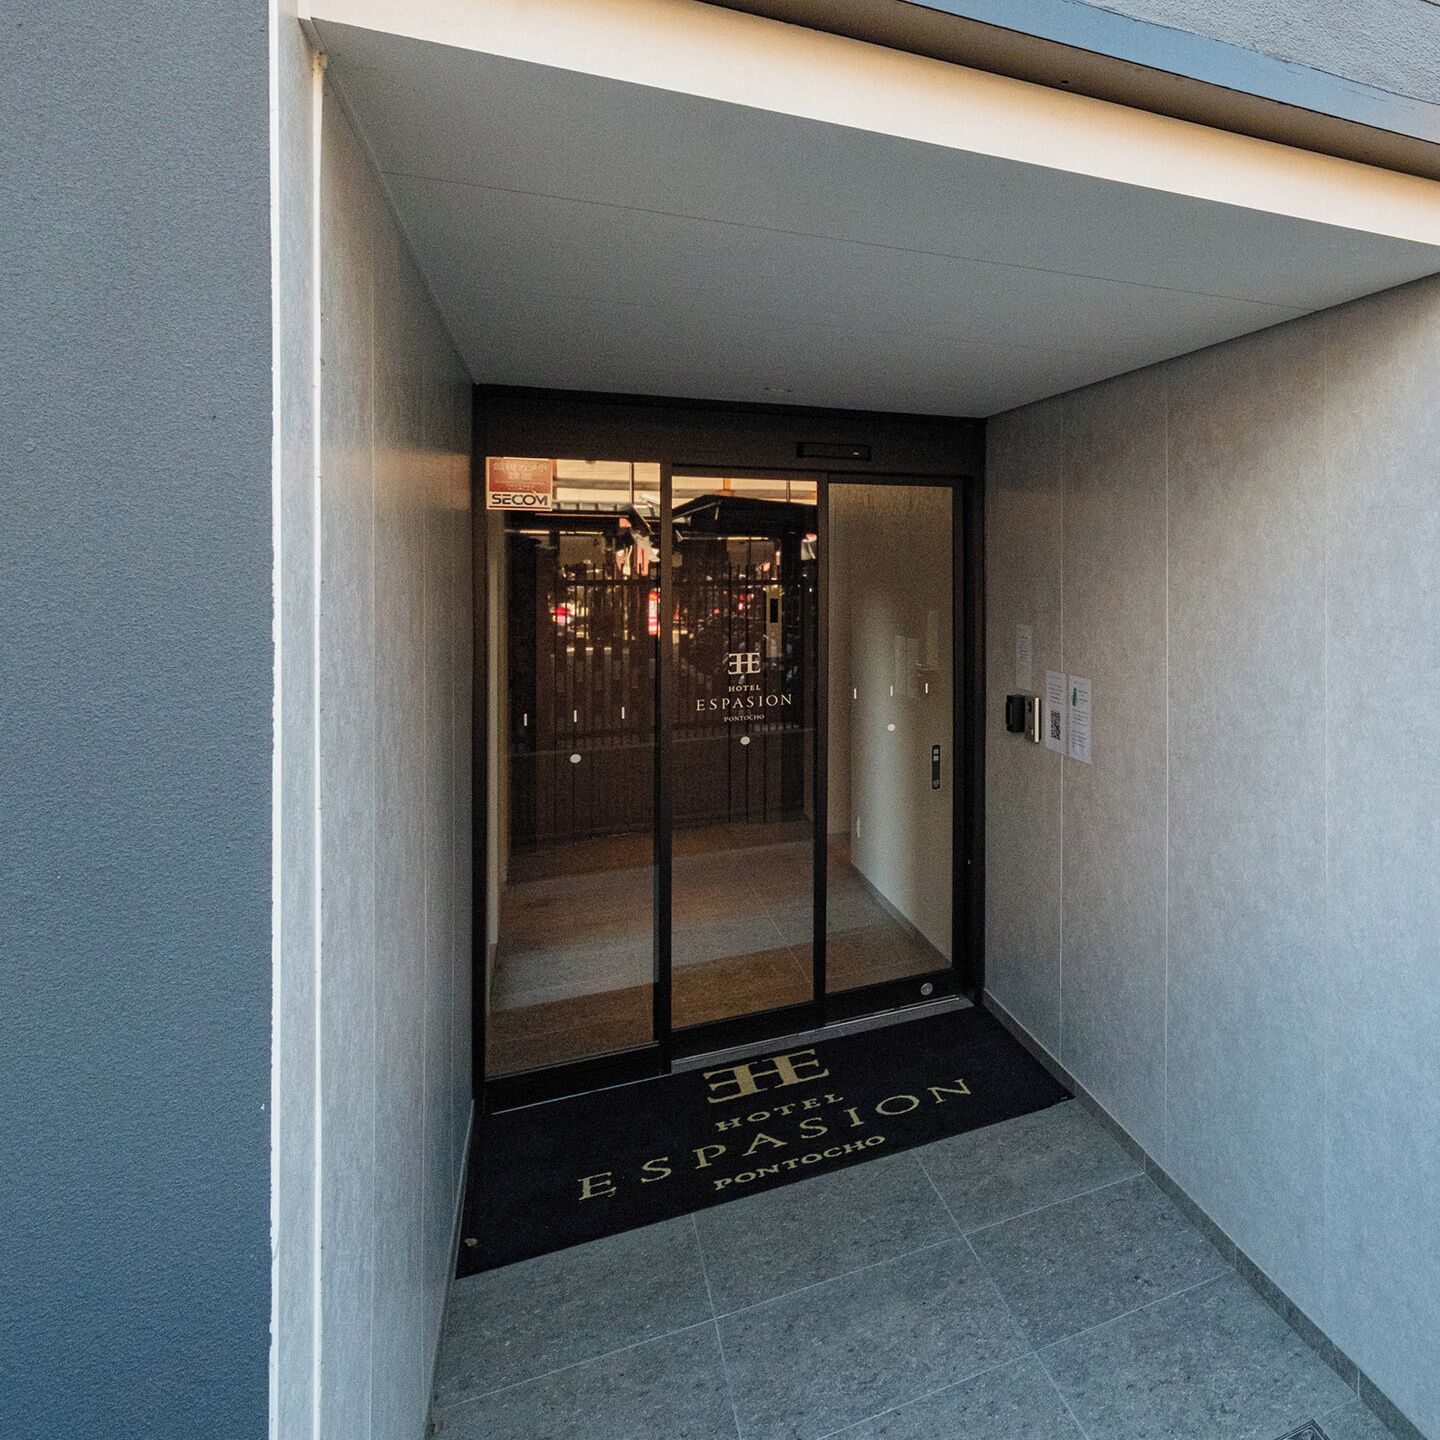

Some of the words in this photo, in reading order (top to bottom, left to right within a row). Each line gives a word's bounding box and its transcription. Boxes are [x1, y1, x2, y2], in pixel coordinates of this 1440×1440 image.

[491, 493, 548, 506] SECOM
[728, 684, 761, 692] HOTEL
[696, 694, 792, 711] ESPASION
[724, 714, 765, 722] PONTOCHO
[714, 1092, 845, 1132] HOTEL
[577, 1078, 973, 1201] ESPASION
[713, 1135, 886, 1192] PONTOCHO
